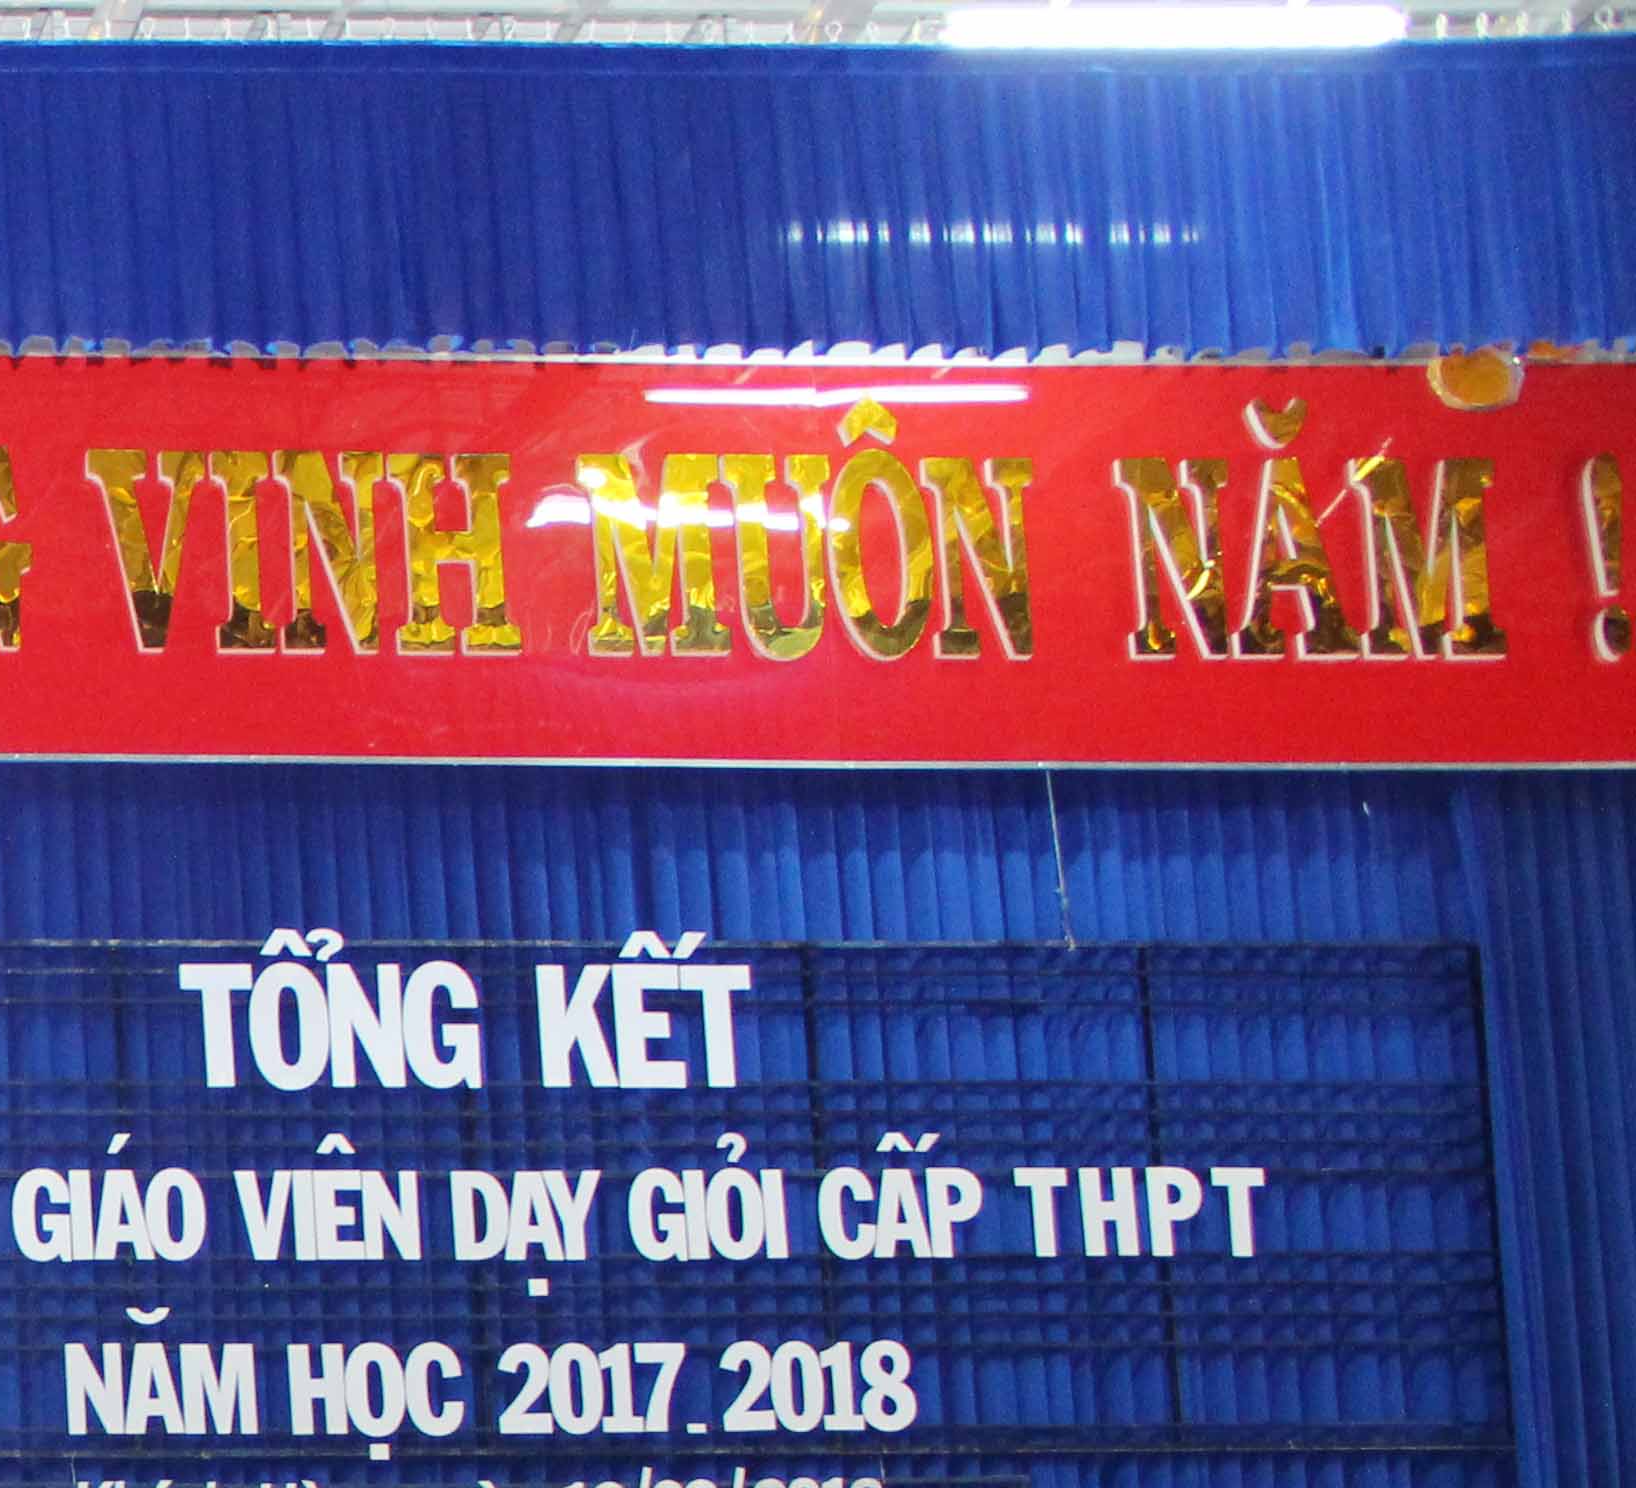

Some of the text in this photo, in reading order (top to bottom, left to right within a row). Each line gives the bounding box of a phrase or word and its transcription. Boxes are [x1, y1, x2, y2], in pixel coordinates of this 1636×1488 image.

[85, 448, 519, 658] VINH
[578, 399, 1034, 662] MUÔN
[1118, 397, 1507, 663] NĂM
[180, 929, 750, 1090] TỔNG KẾT
[13, 1134, 205, 1261] GIÁO
[234, 1134, 421, 1260] VIÊN
[451, 1170, 600, 1296] DẠY
[630, 1133, 788, 1261] GIỎI
[820, 1133, 982, 1259] CẤP
[1015, 1167, 1264, 1256] THPT
[65, 1308, 258, 1434] NĂM
[288, 1342, 464, 1460] HỌC
